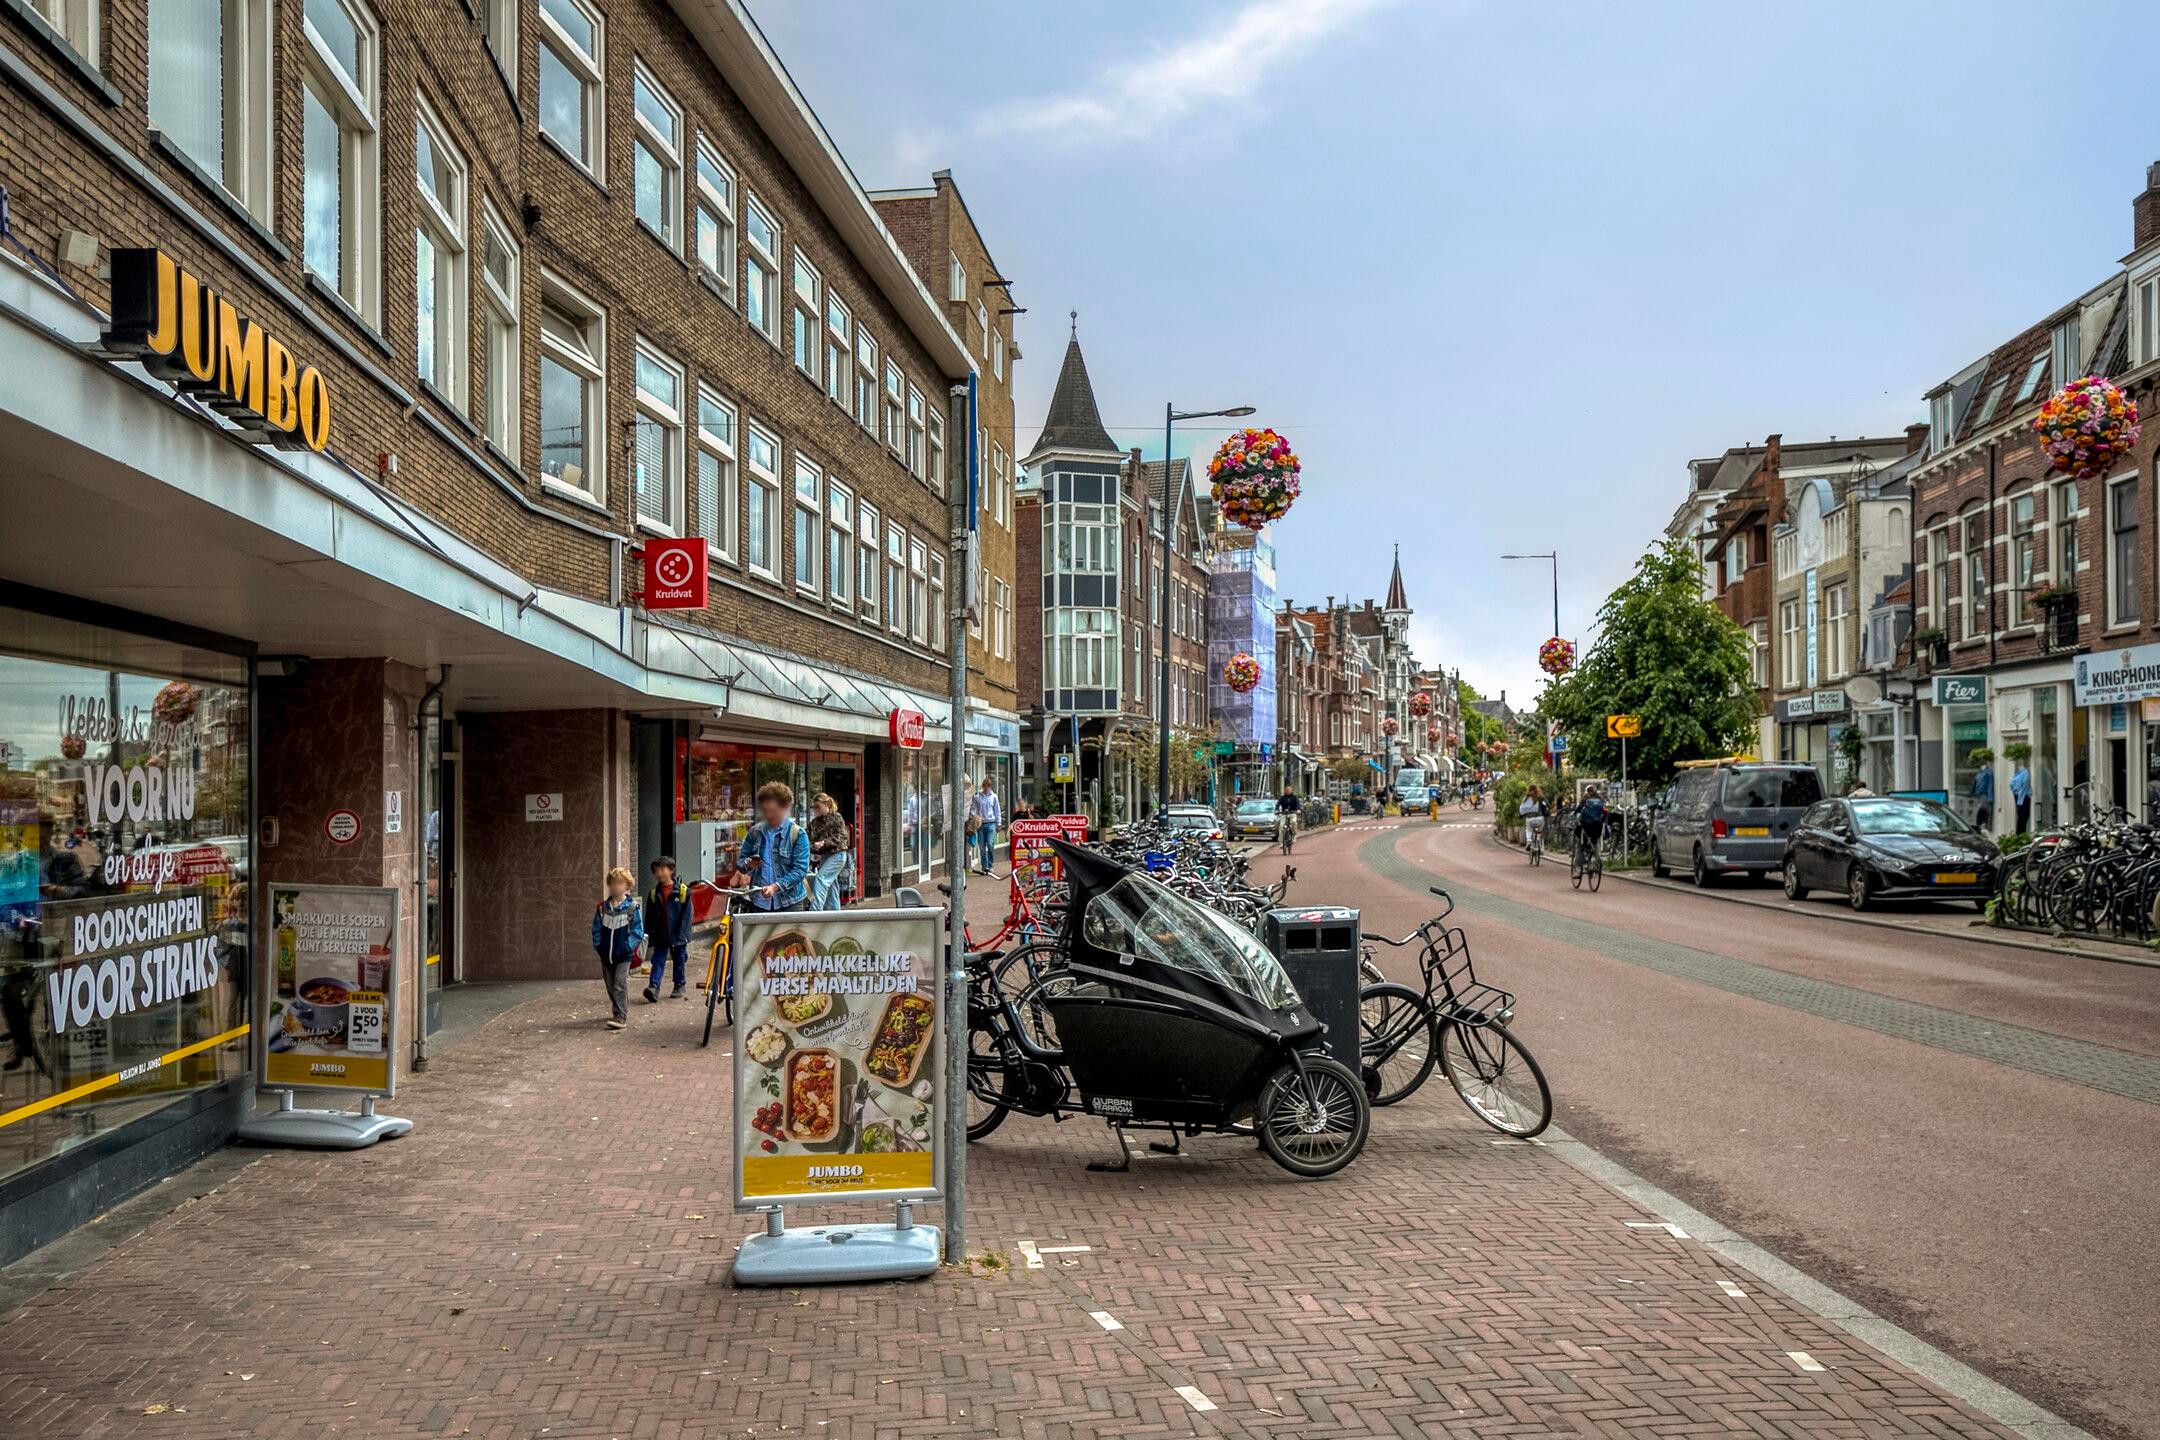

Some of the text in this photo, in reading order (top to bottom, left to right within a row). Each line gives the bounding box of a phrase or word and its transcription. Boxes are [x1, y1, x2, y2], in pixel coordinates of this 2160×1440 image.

[146, 250, 331, 453] JUMBO
[655, 588, 693, 599] Kruidvat
[1945, 680, 1979, 700] Fier
[1060, 756, 1069, 768] P
[84, 764, 195, 826] VOOR NU
[1024, 822, 1060, 831] Kruidvat
[1057, 816, 1086, 825] Kruidvat
[132, 833, 155, 882] al
[154, 842, 176, 895] je
[74, 895, 203, 956] BOODSCHAPPEN
[281, 912, 386, 928] SMAAKVOLLE SOEPEN
[300, 926, 368, 941] DIE JE METEEN
[295, 940, 370, 955] KUNT SERVEREN
[765, 953, 912, 974] MMMMAKKELIJKE
[49, 934, 219, 1034] VOOR STRAKS
[759, 976, 918, 996] VERSE MAALTIJDEN
[354, 1006, 378, 1014] 2 VOOR
[119, 1056, 162, 1081] WELKOM BIJ JUMBO
[310, 1062, 346, 1073] JUMBO
[1101, 1098, 1132, 1107] URBAN
[807, 1164, 864, 1178] JUMBO
